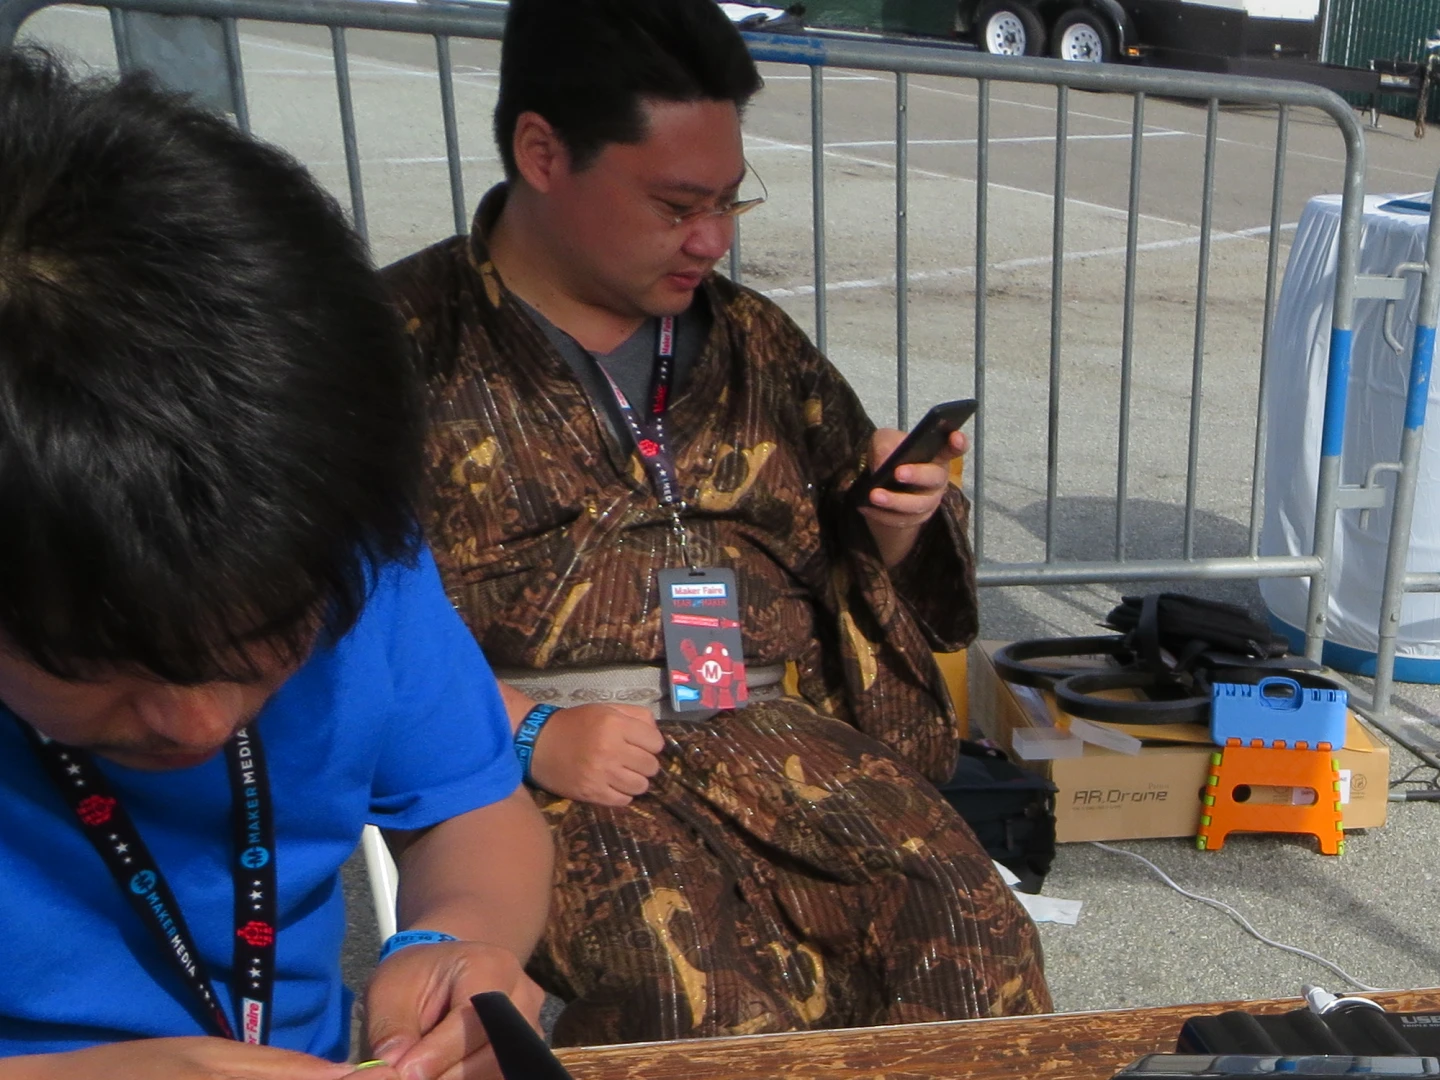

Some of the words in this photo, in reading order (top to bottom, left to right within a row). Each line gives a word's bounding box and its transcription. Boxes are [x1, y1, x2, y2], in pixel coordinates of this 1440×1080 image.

[674, 587, 700, 595] Maker
[703, 586, 722, 595] Faire
[1072, 789, 1168, 805] AR.Drone
[245, 1002, 261, 1034] Faire
